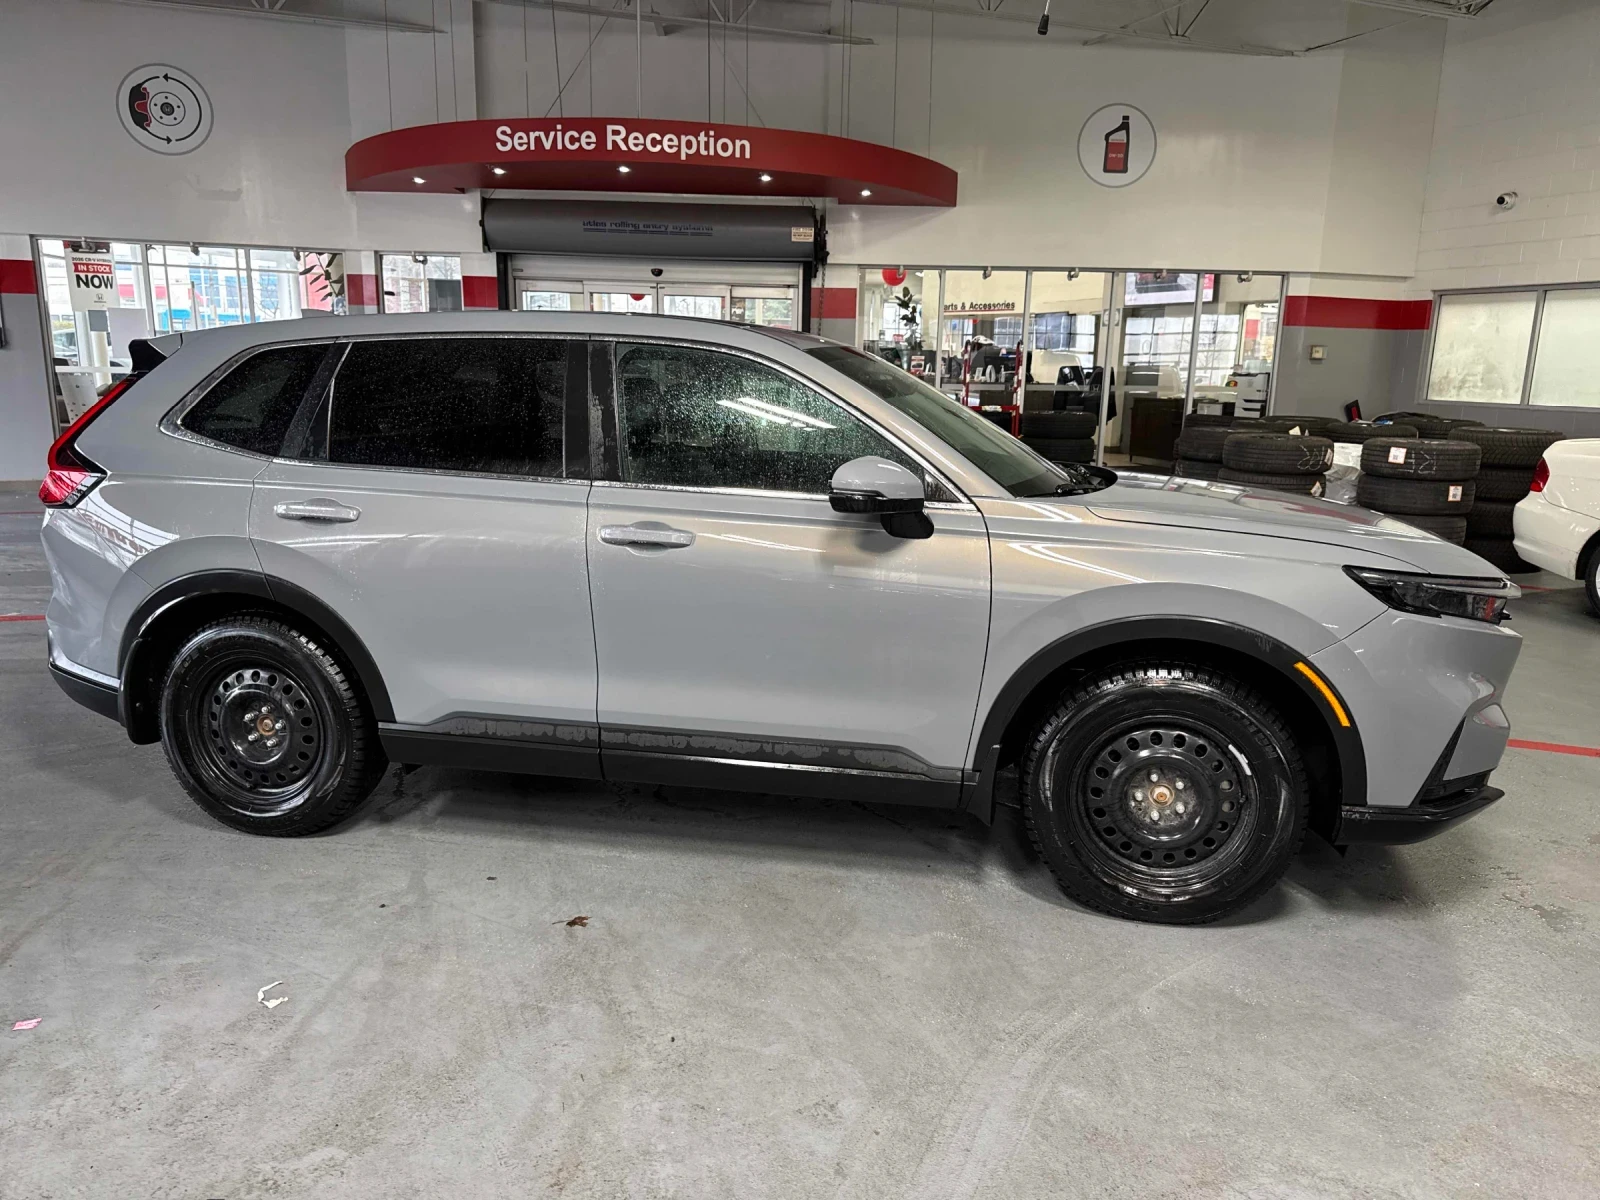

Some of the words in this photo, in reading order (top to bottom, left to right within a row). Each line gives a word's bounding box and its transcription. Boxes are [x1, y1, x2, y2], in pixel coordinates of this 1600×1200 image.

[495, 124, 597, 152] Service
[606, 124, 751, 161] Reception
[609, 221, 640, 230] rolling
[77, 264, 88, 272] IN
[88, 264, 111, 273] STOCK
[75, 273, 114, 290] NOW
[943, 302, 958, 311] arts
[960, 301, 966, 310] &
[968, 301, 1016, 311] Accessories
